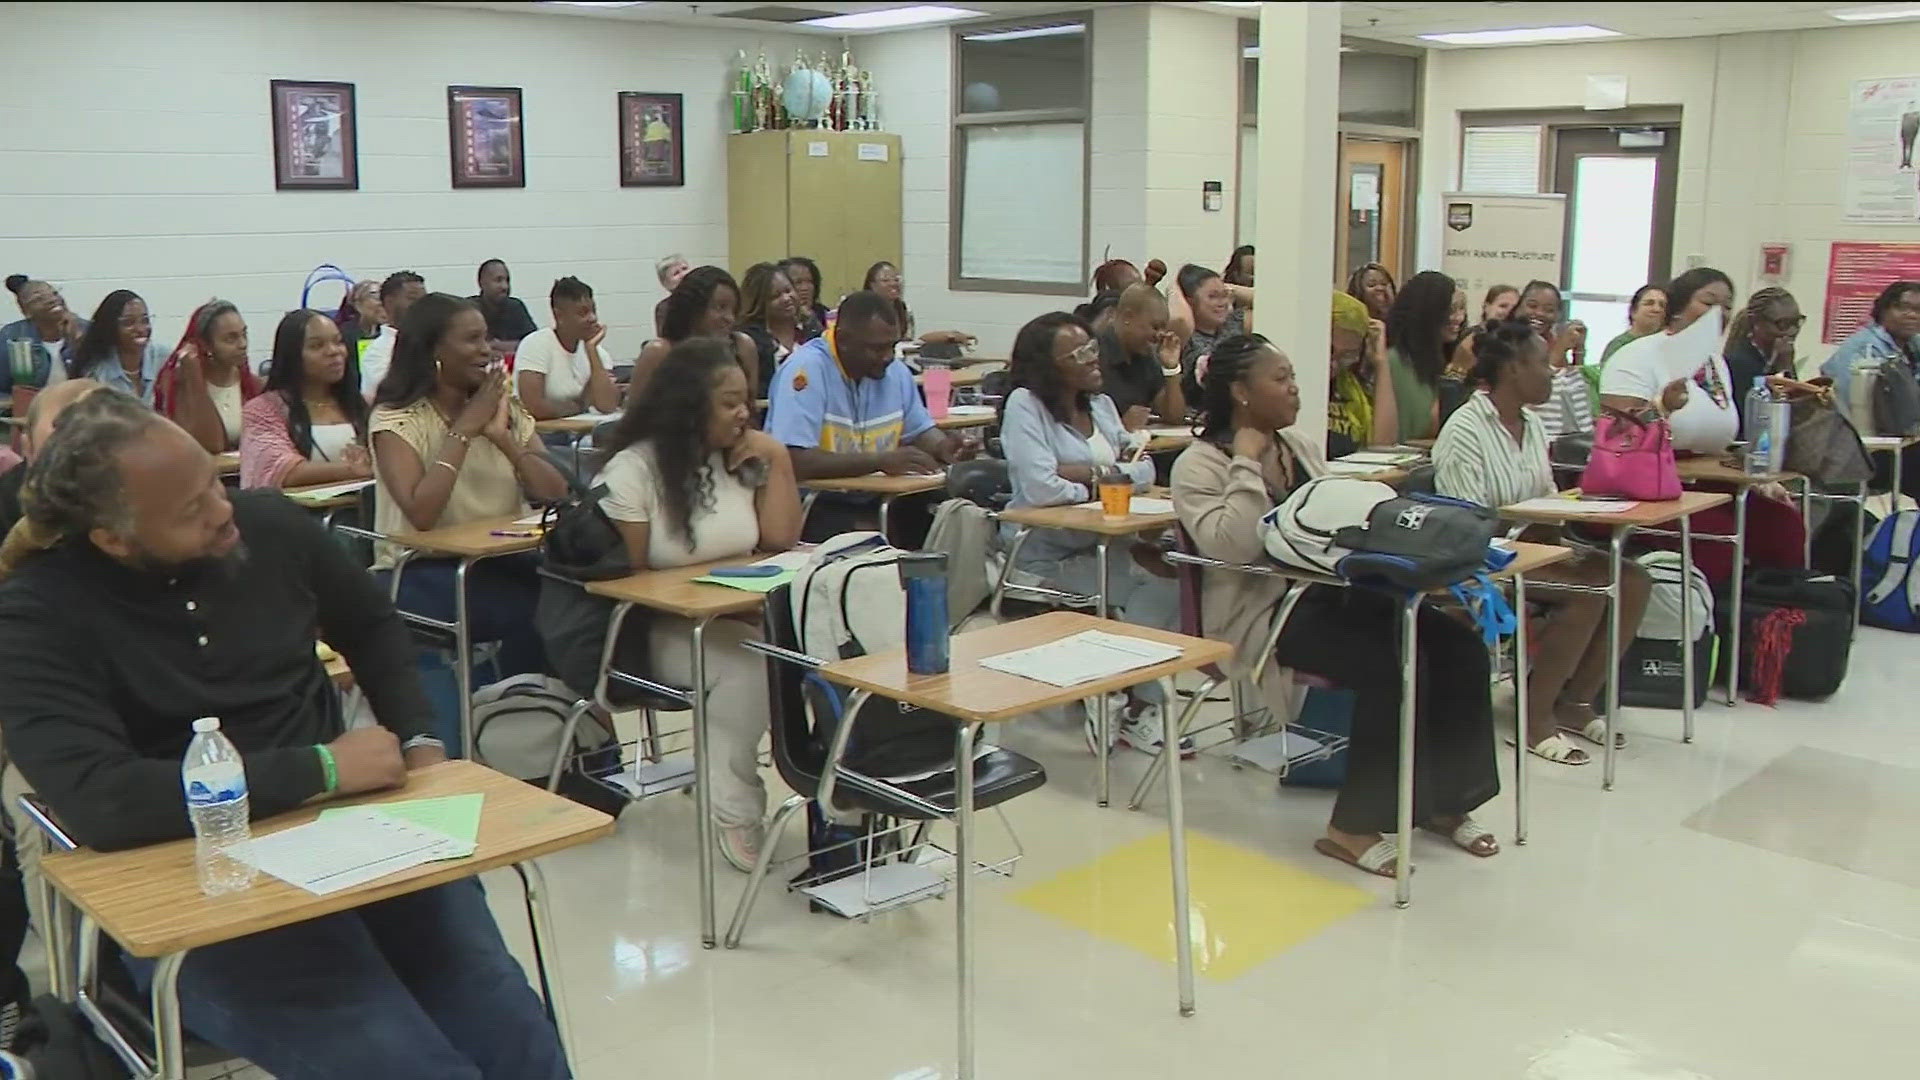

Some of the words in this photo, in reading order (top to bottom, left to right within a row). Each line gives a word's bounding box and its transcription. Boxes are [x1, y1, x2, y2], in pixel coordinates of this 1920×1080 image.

[1446, 249, 1470, 257] ARMY
[1474, 250, 1498, 259] RANK
[1501, 251, 1556, 261] STRUCTURE
